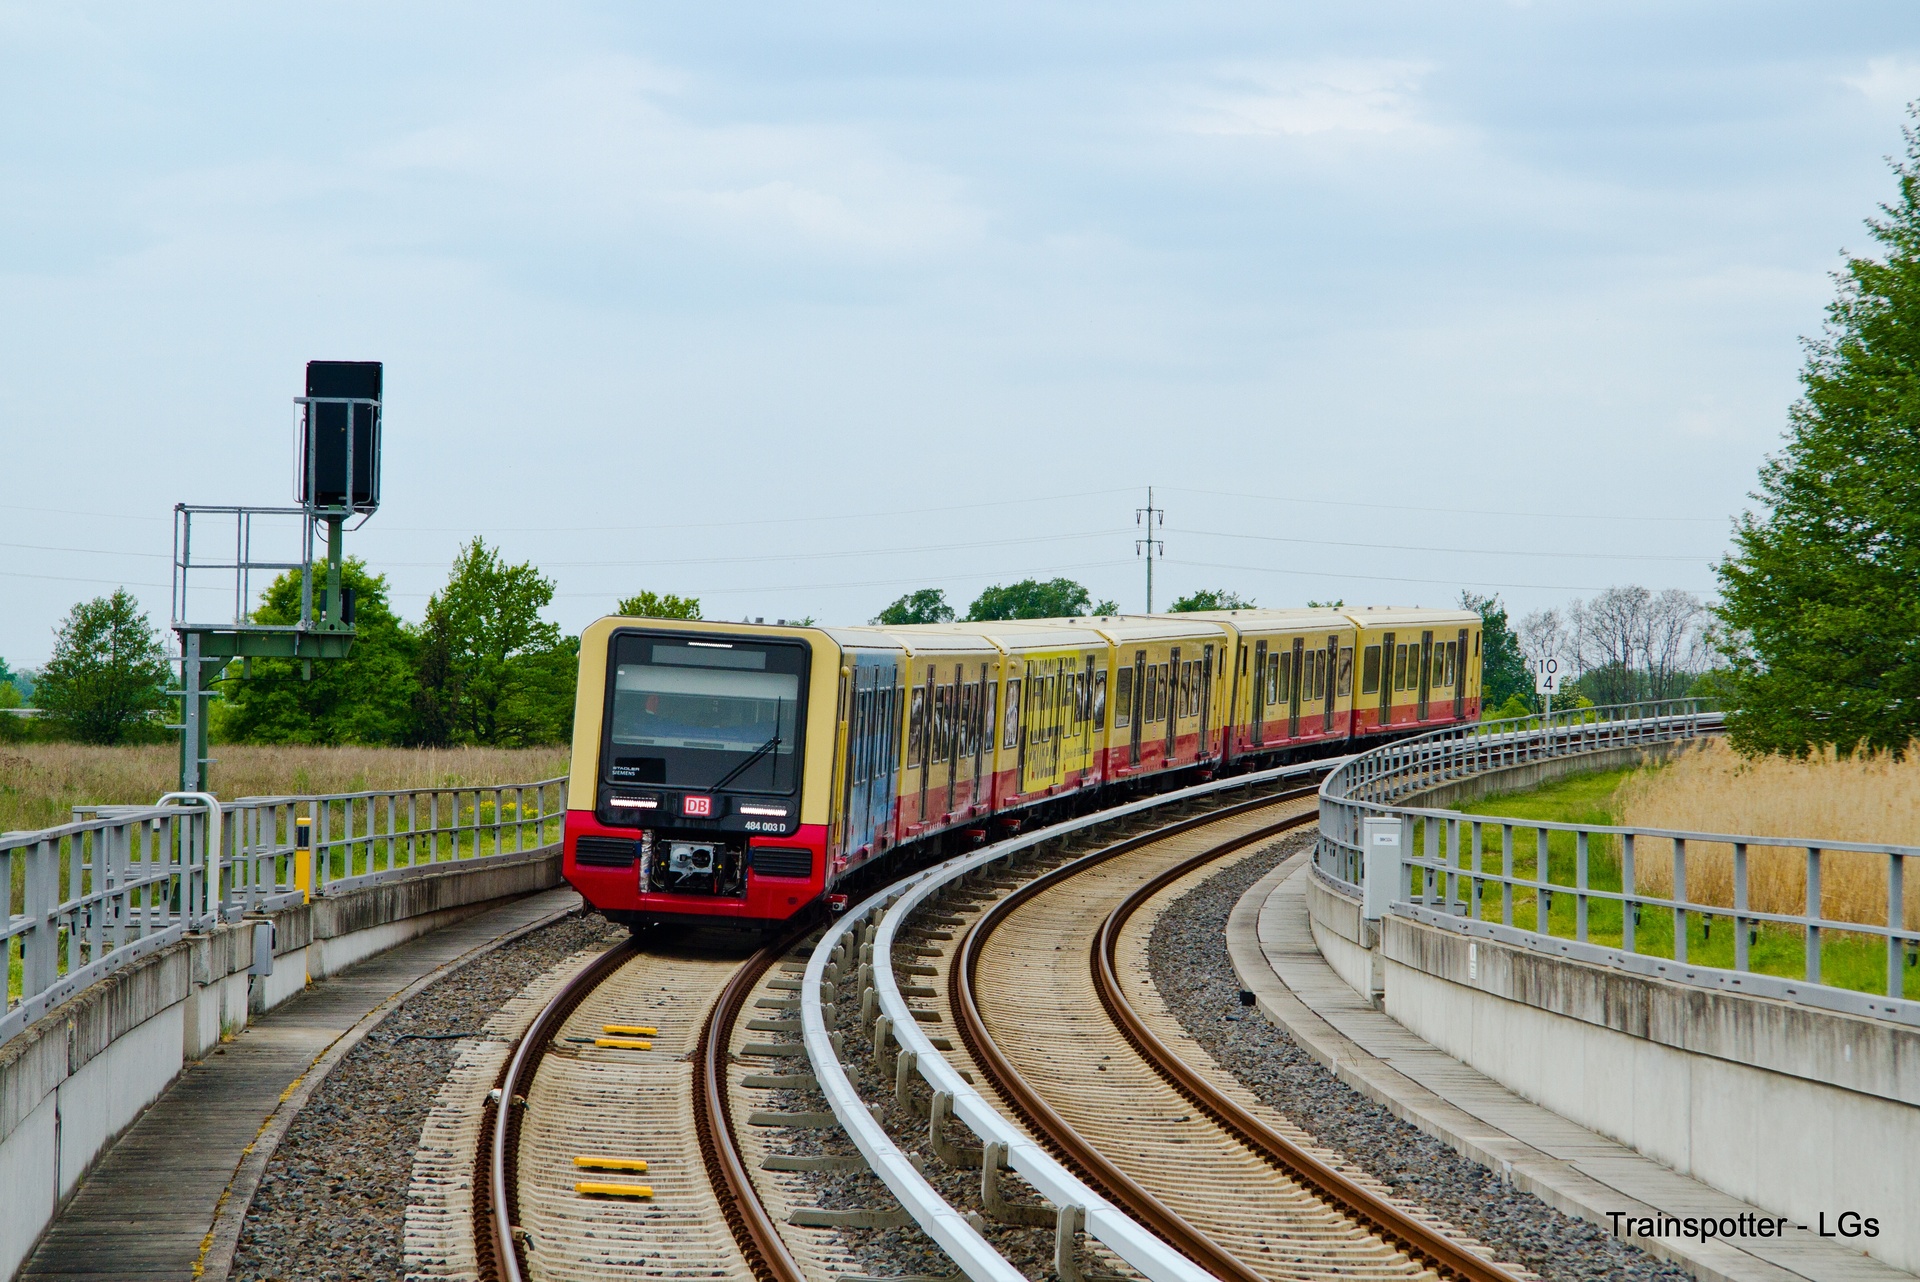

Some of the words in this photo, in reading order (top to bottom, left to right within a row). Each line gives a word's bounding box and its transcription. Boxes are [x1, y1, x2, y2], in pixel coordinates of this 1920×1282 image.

[1539, 659, 1557, 673] 10
[1543, 676, 1553, 690] 4
[687, 799, 707, 813] DB
[745, 821, 760, 831] 484
[762, 822, 778, 832] 003
[779, 823, 786, 832] D
